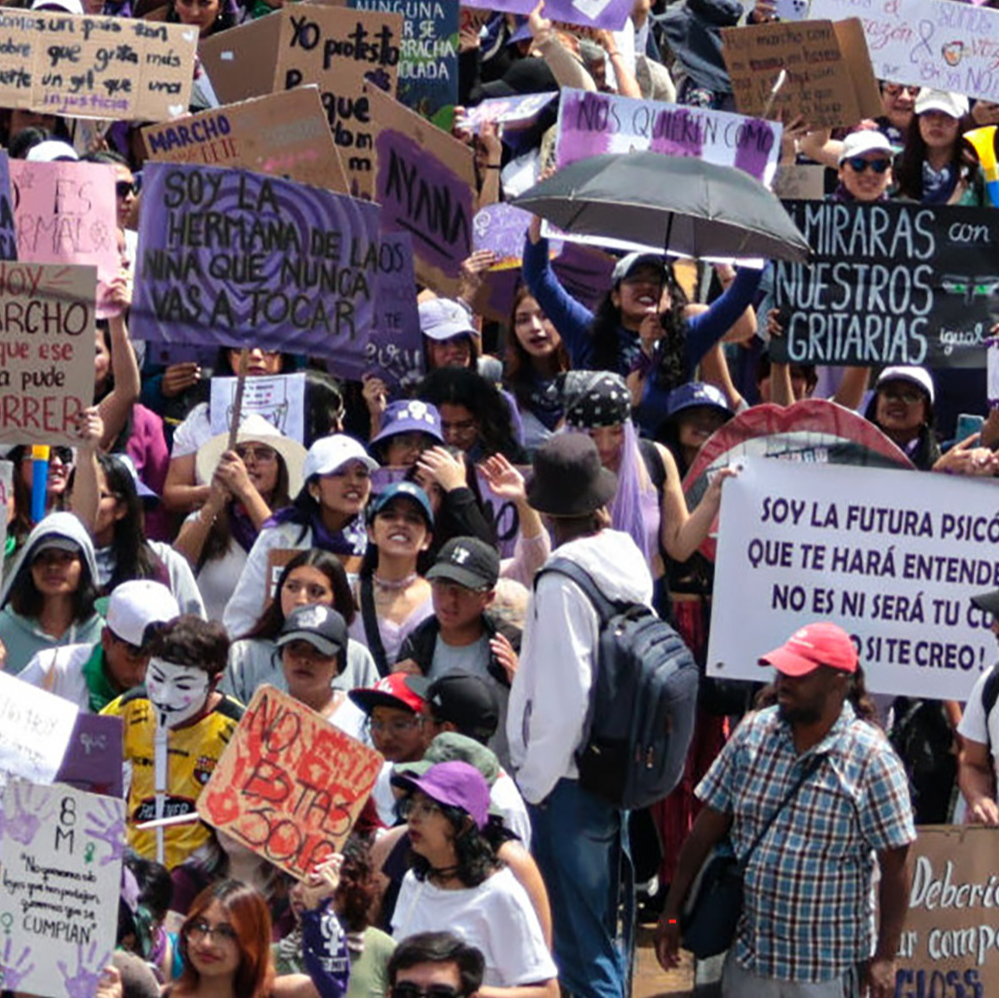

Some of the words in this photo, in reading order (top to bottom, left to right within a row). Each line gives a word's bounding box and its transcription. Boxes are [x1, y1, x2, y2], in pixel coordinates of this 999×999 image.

[289, 15, 320, 50] YO
[146, 114, 231, 154] MARCHO
[164, 170, 228, 209] SOY
[237, 174, 279, 212] LA
[168, 217, 300, 252] HERMANA
[804, 206, 936, 259] MIRARAS
[949, 221, 989, 242] con
[775, 264, 935, 315] NUESTROS
[242, 295, 355, 338] TOCAR
[38, 339, 73, 358] ese
[787, 315, 927, 365] GRITARIAS
[21, 367, 65, 390] pude
[761, 497, 805, 523] SOY
[810, 501, 839, 529] LA
[846, 505, 933, 536] FUTURA
[748, 538, 793, 568] QUE
[800, 543, 826, 569] TE
[831, 545, 896, 577] HARÁ
[771, 584, 805, 612] NO
[812, 588, 835, 614] ES
[841, 590, 864, 617] NI
[870, 592, 923, 623] SERÁ
[931, 599, 959, 626] TU
[885, 638, 909, 666] TE
